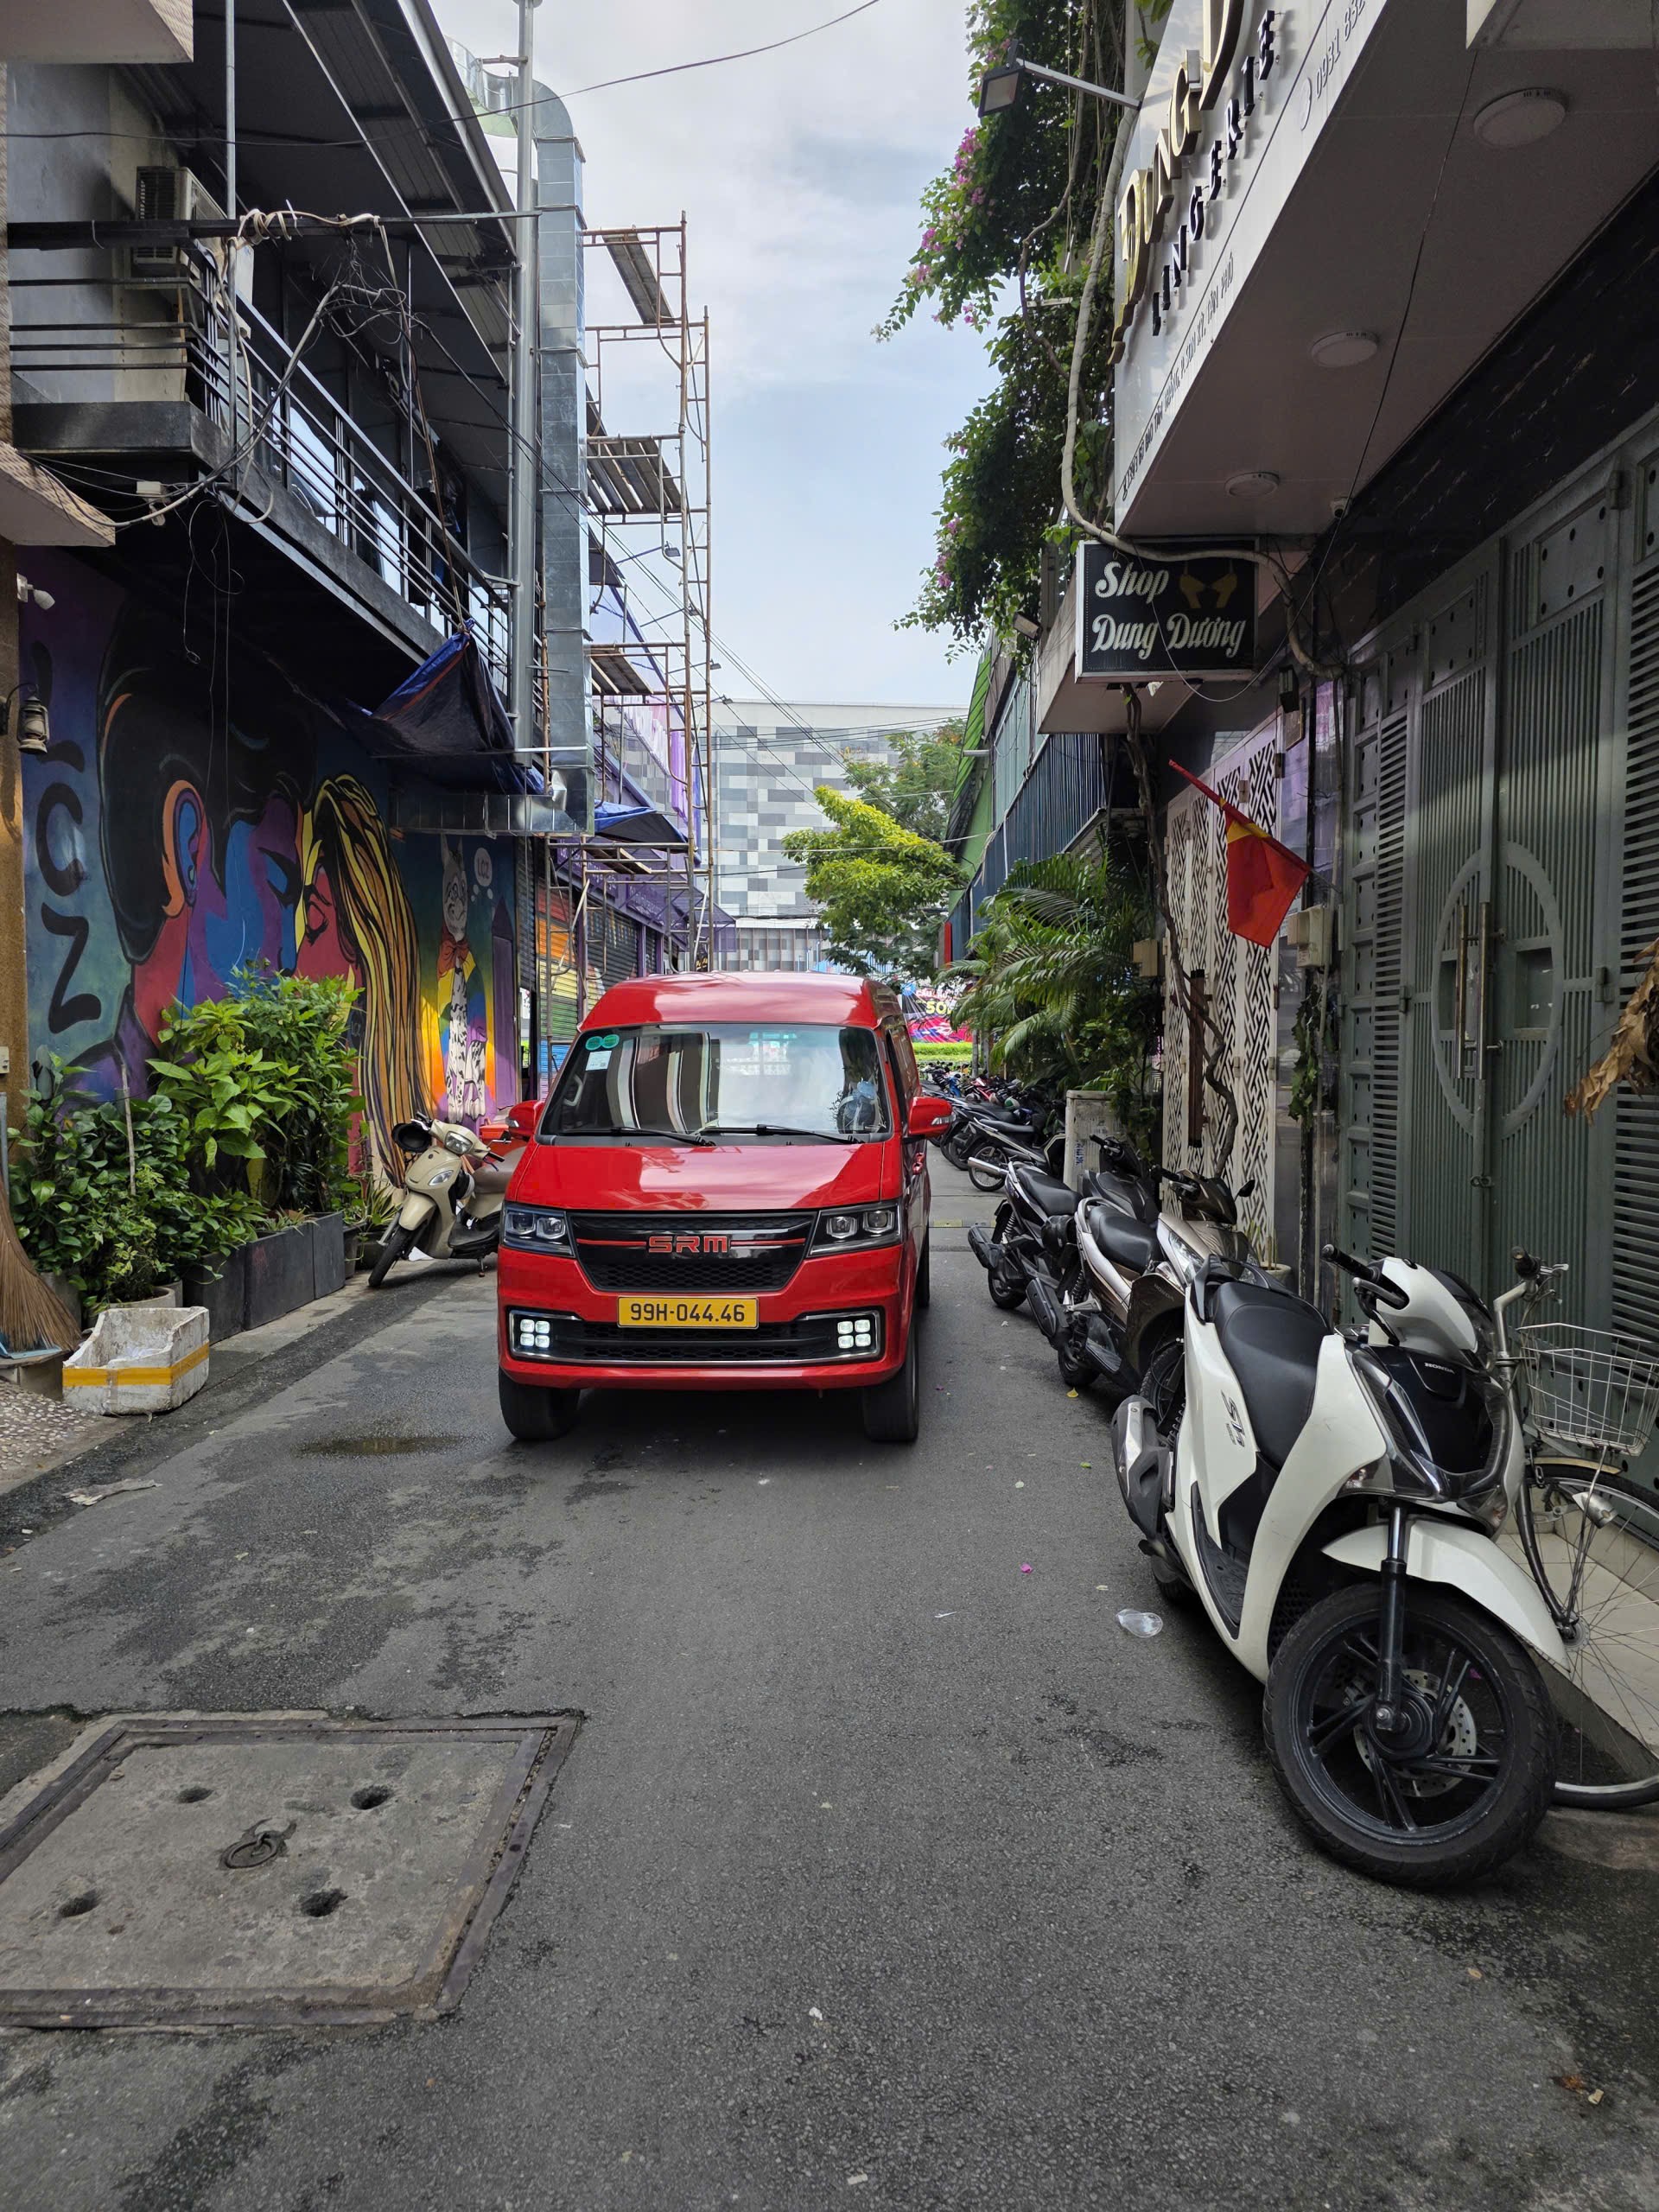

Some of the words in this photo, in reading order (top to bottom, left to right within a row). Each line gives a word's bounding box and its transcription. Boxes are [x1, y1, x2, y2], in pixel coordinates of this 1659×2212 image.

[1314, 29, 1342, 99] 0931
[1152, 10, 1275, 336] LINGERIE
[1095, 561, 1170, 605] Shop
[1090, 613, 1159, 660] Dung
[1166, 612, 1247, 659] Dương
[647, 1235, 730, 1255] SRM
[1154, 1283, 1175, 1302] HONDA
[629, 1302, 746, 1324] 99H-044.46
[1423, 1362, 1456, 1375] HONDA
